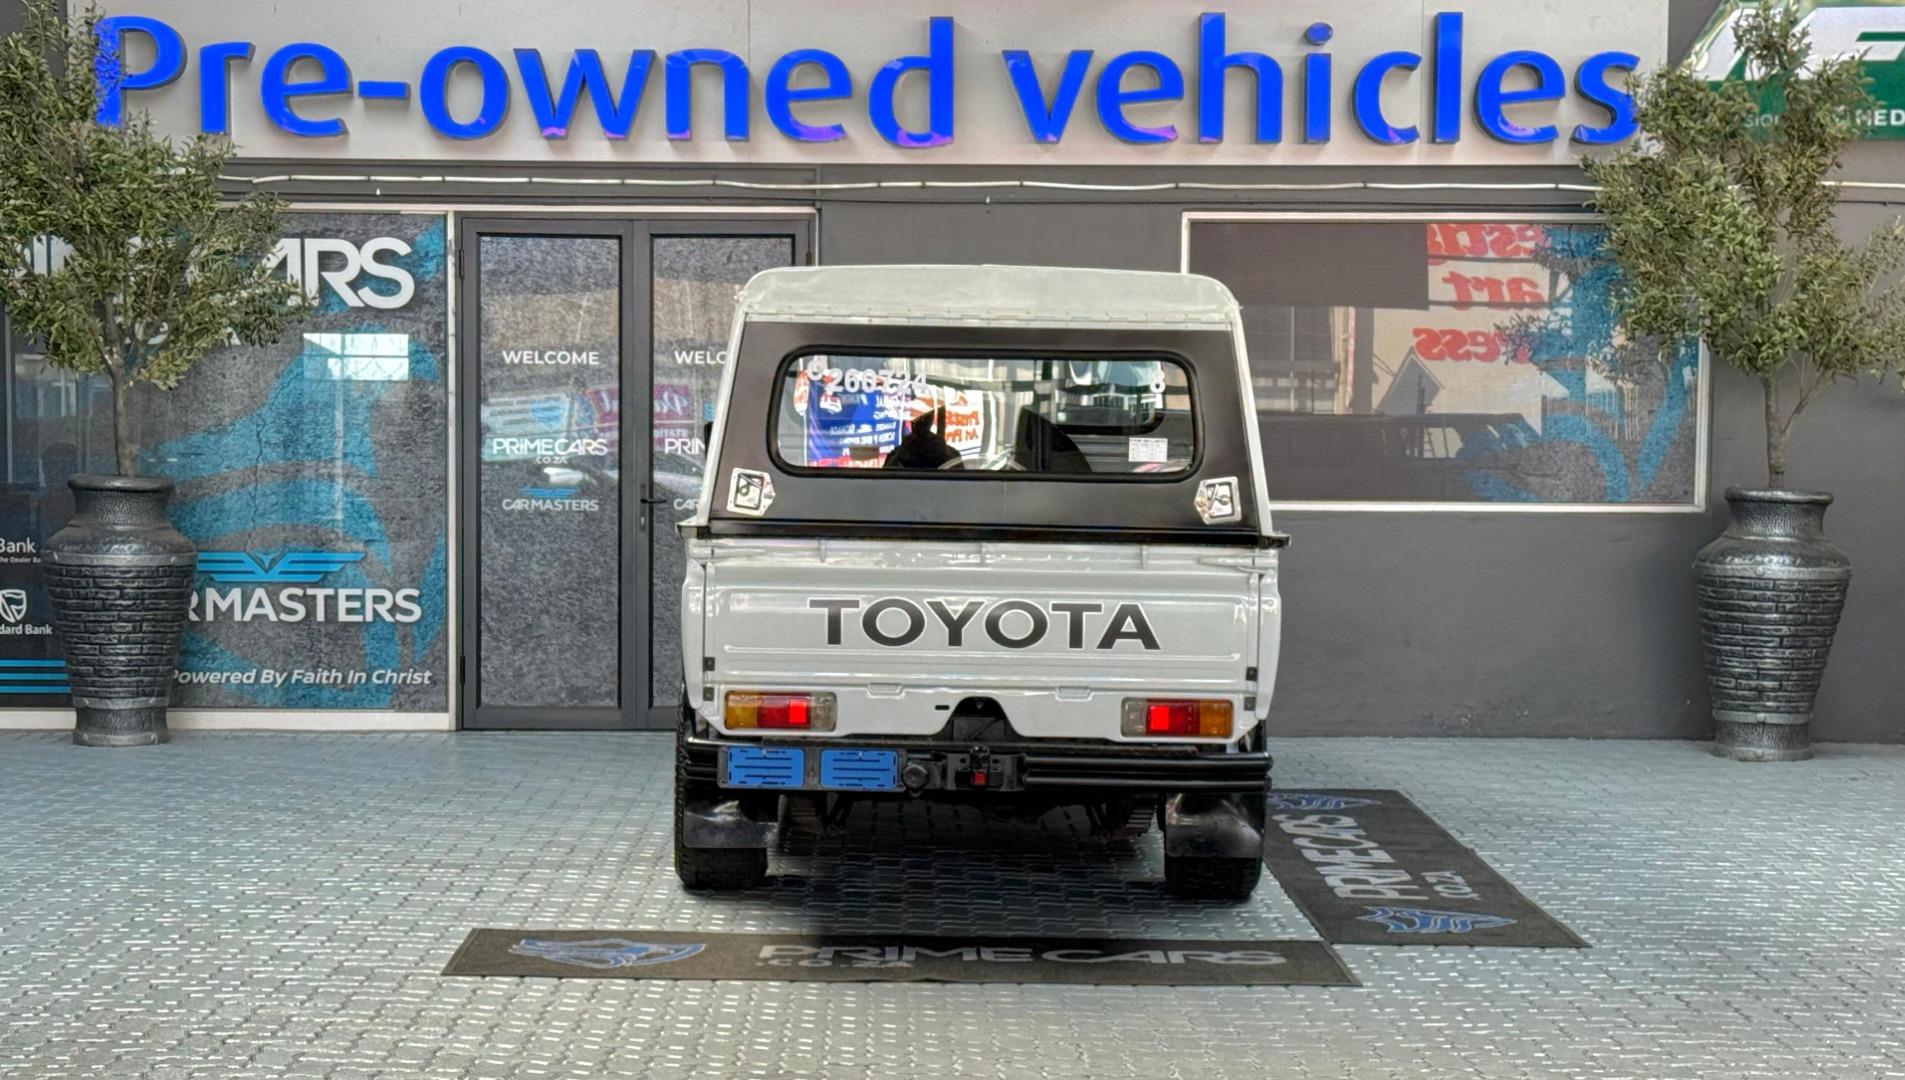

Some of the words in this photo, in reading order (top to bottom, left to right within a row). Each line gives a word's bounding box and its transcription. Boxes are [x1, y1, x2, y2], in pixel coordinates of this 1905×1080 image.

[94, 15, 955, 149] Pre-owned
[1002, 12, 1642, 146] vehicles
[502, 350, 600, 366] WELCOME
[25, 625, 53, 634] Bank
[808, 597, 1162, 651] TOYOTA
[260, 669, 287, 687] By
[291, 669, 343, 684] Faith
[347, 669, 367, 684] In
[371, 669, 433, 684] Christ
